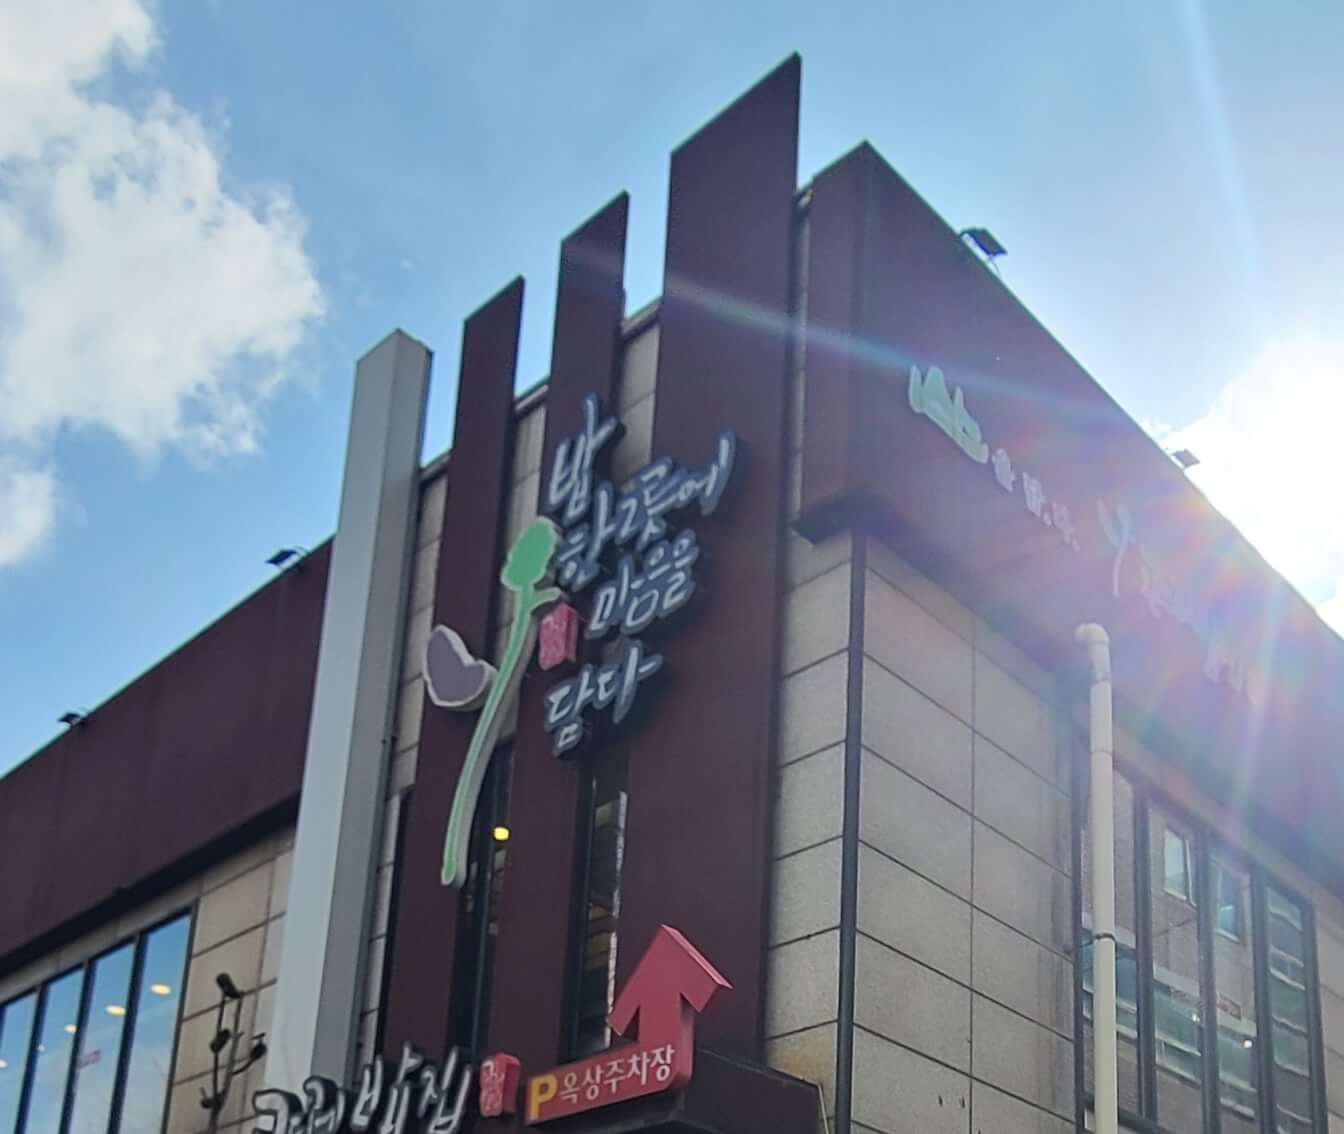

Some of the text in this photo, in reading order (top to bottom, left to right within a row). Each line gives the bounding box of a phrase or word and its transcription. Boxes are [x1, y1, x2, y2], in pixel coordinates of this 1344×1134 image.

[585, 528, 702, 640] 마음을
[544, 640, 664, 757] 담다
[529, 1073, 557, 1122] P
[560, 1044, 676, 1104] 옥상주차장
